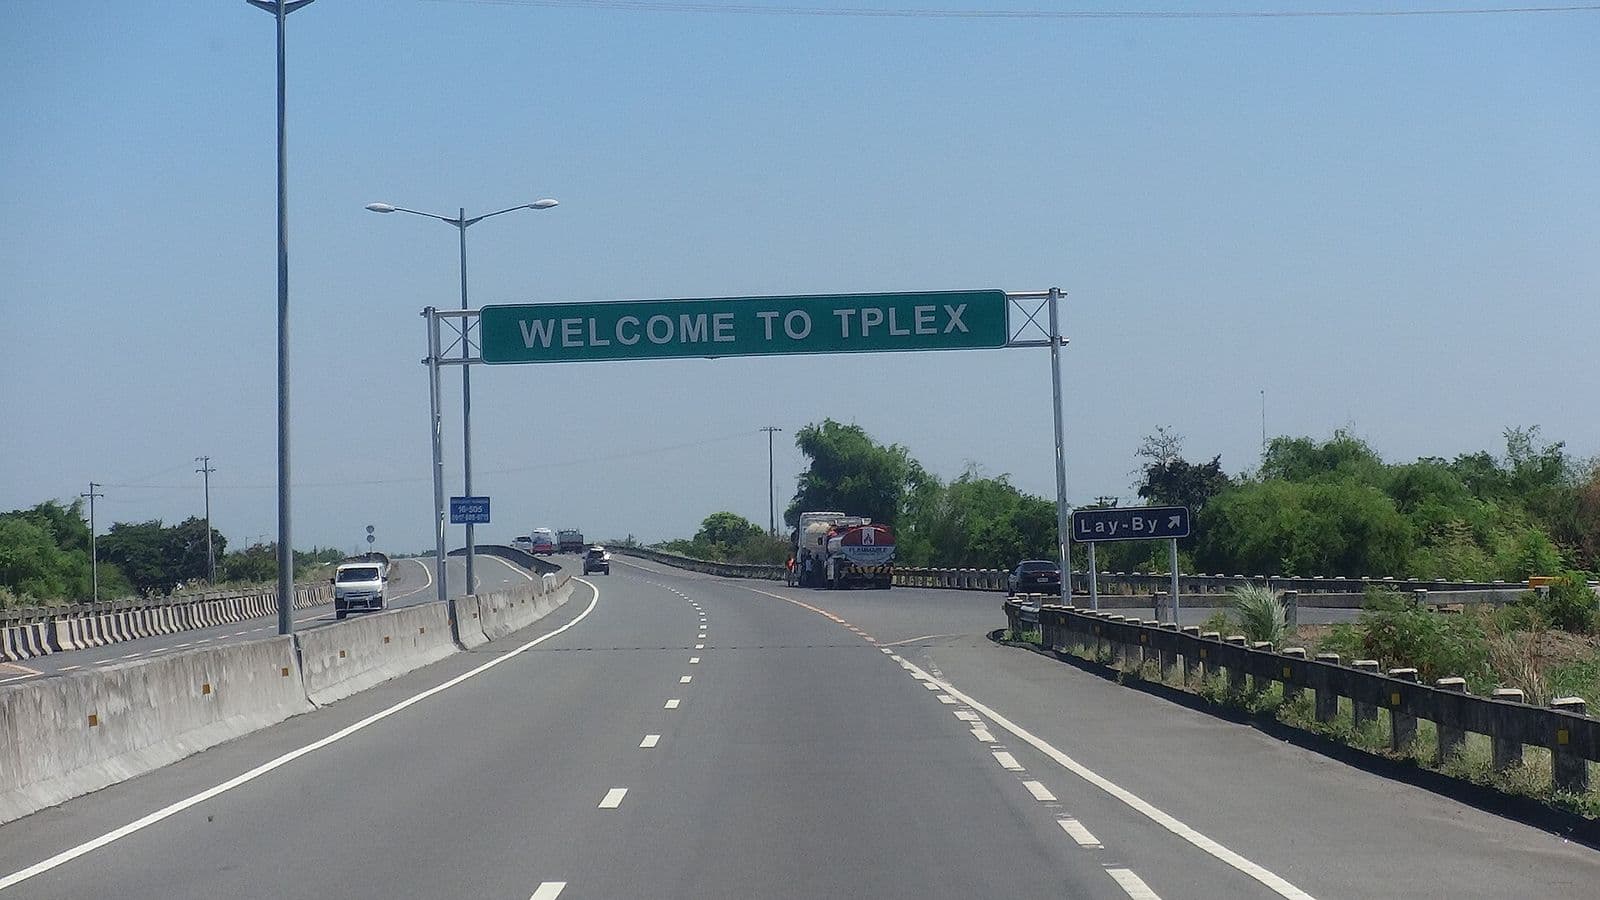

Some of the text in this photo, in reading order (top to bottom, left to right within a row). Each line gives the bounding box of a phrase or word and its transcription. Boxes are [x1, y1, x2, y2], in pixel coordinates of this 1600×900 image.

[518, 303, 969, 348] WELCOME TO TPLEX
[1080, 516, 1158, 535] Lay-By
